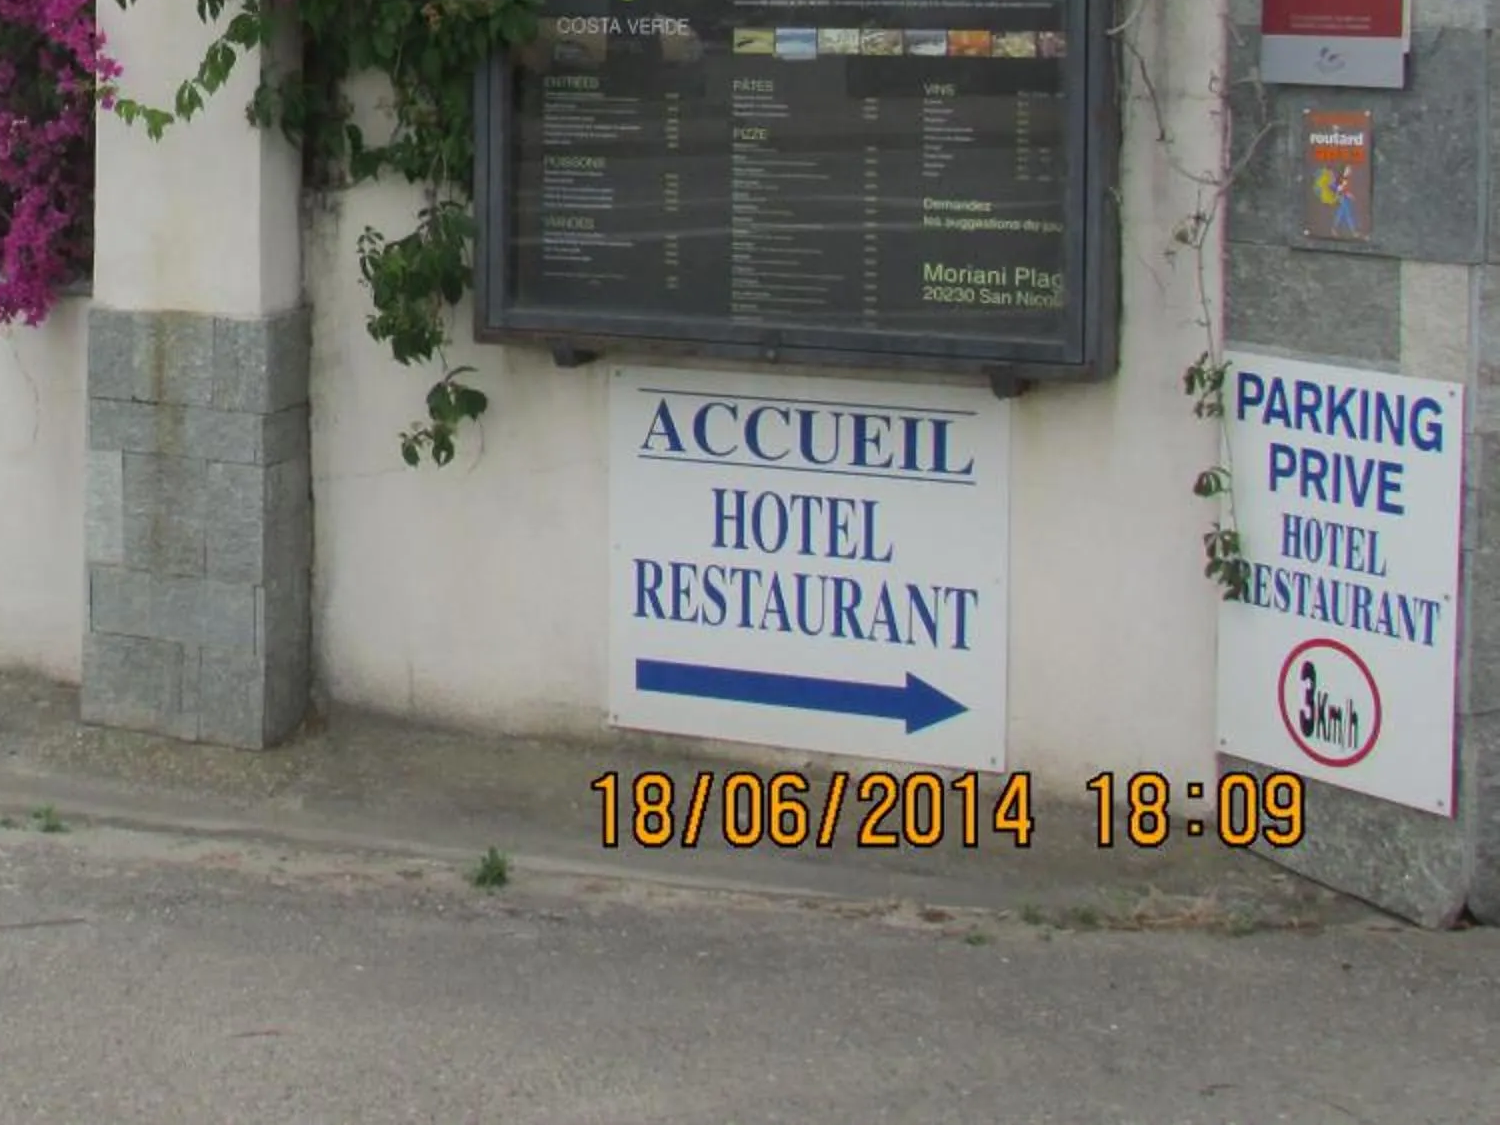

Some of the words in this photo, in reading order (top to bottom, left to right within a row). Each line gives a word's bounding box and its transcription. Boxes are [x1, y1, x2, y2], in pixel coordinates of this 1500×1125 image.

[557, 17, 622, 34] COSTA
[627, 18, 690, 36] VERDE
[1309, 131, 1364, 147] routard
[922, 285, 975, 303] 20230
[979, 288, 1012, 305] San
[923, 262, 1007, 286] Moriani
[640, 398, 975, 475] ACCUEIL
[1236, 372, 1444, 452] PARKING
[1268, 442, 1405, 515] PRIVE
[711, 488, 894, 563] HOTEL
[1281, 512, 1387, 577] HOTEL
[632, 558, 979, 651] RESTAURANT
